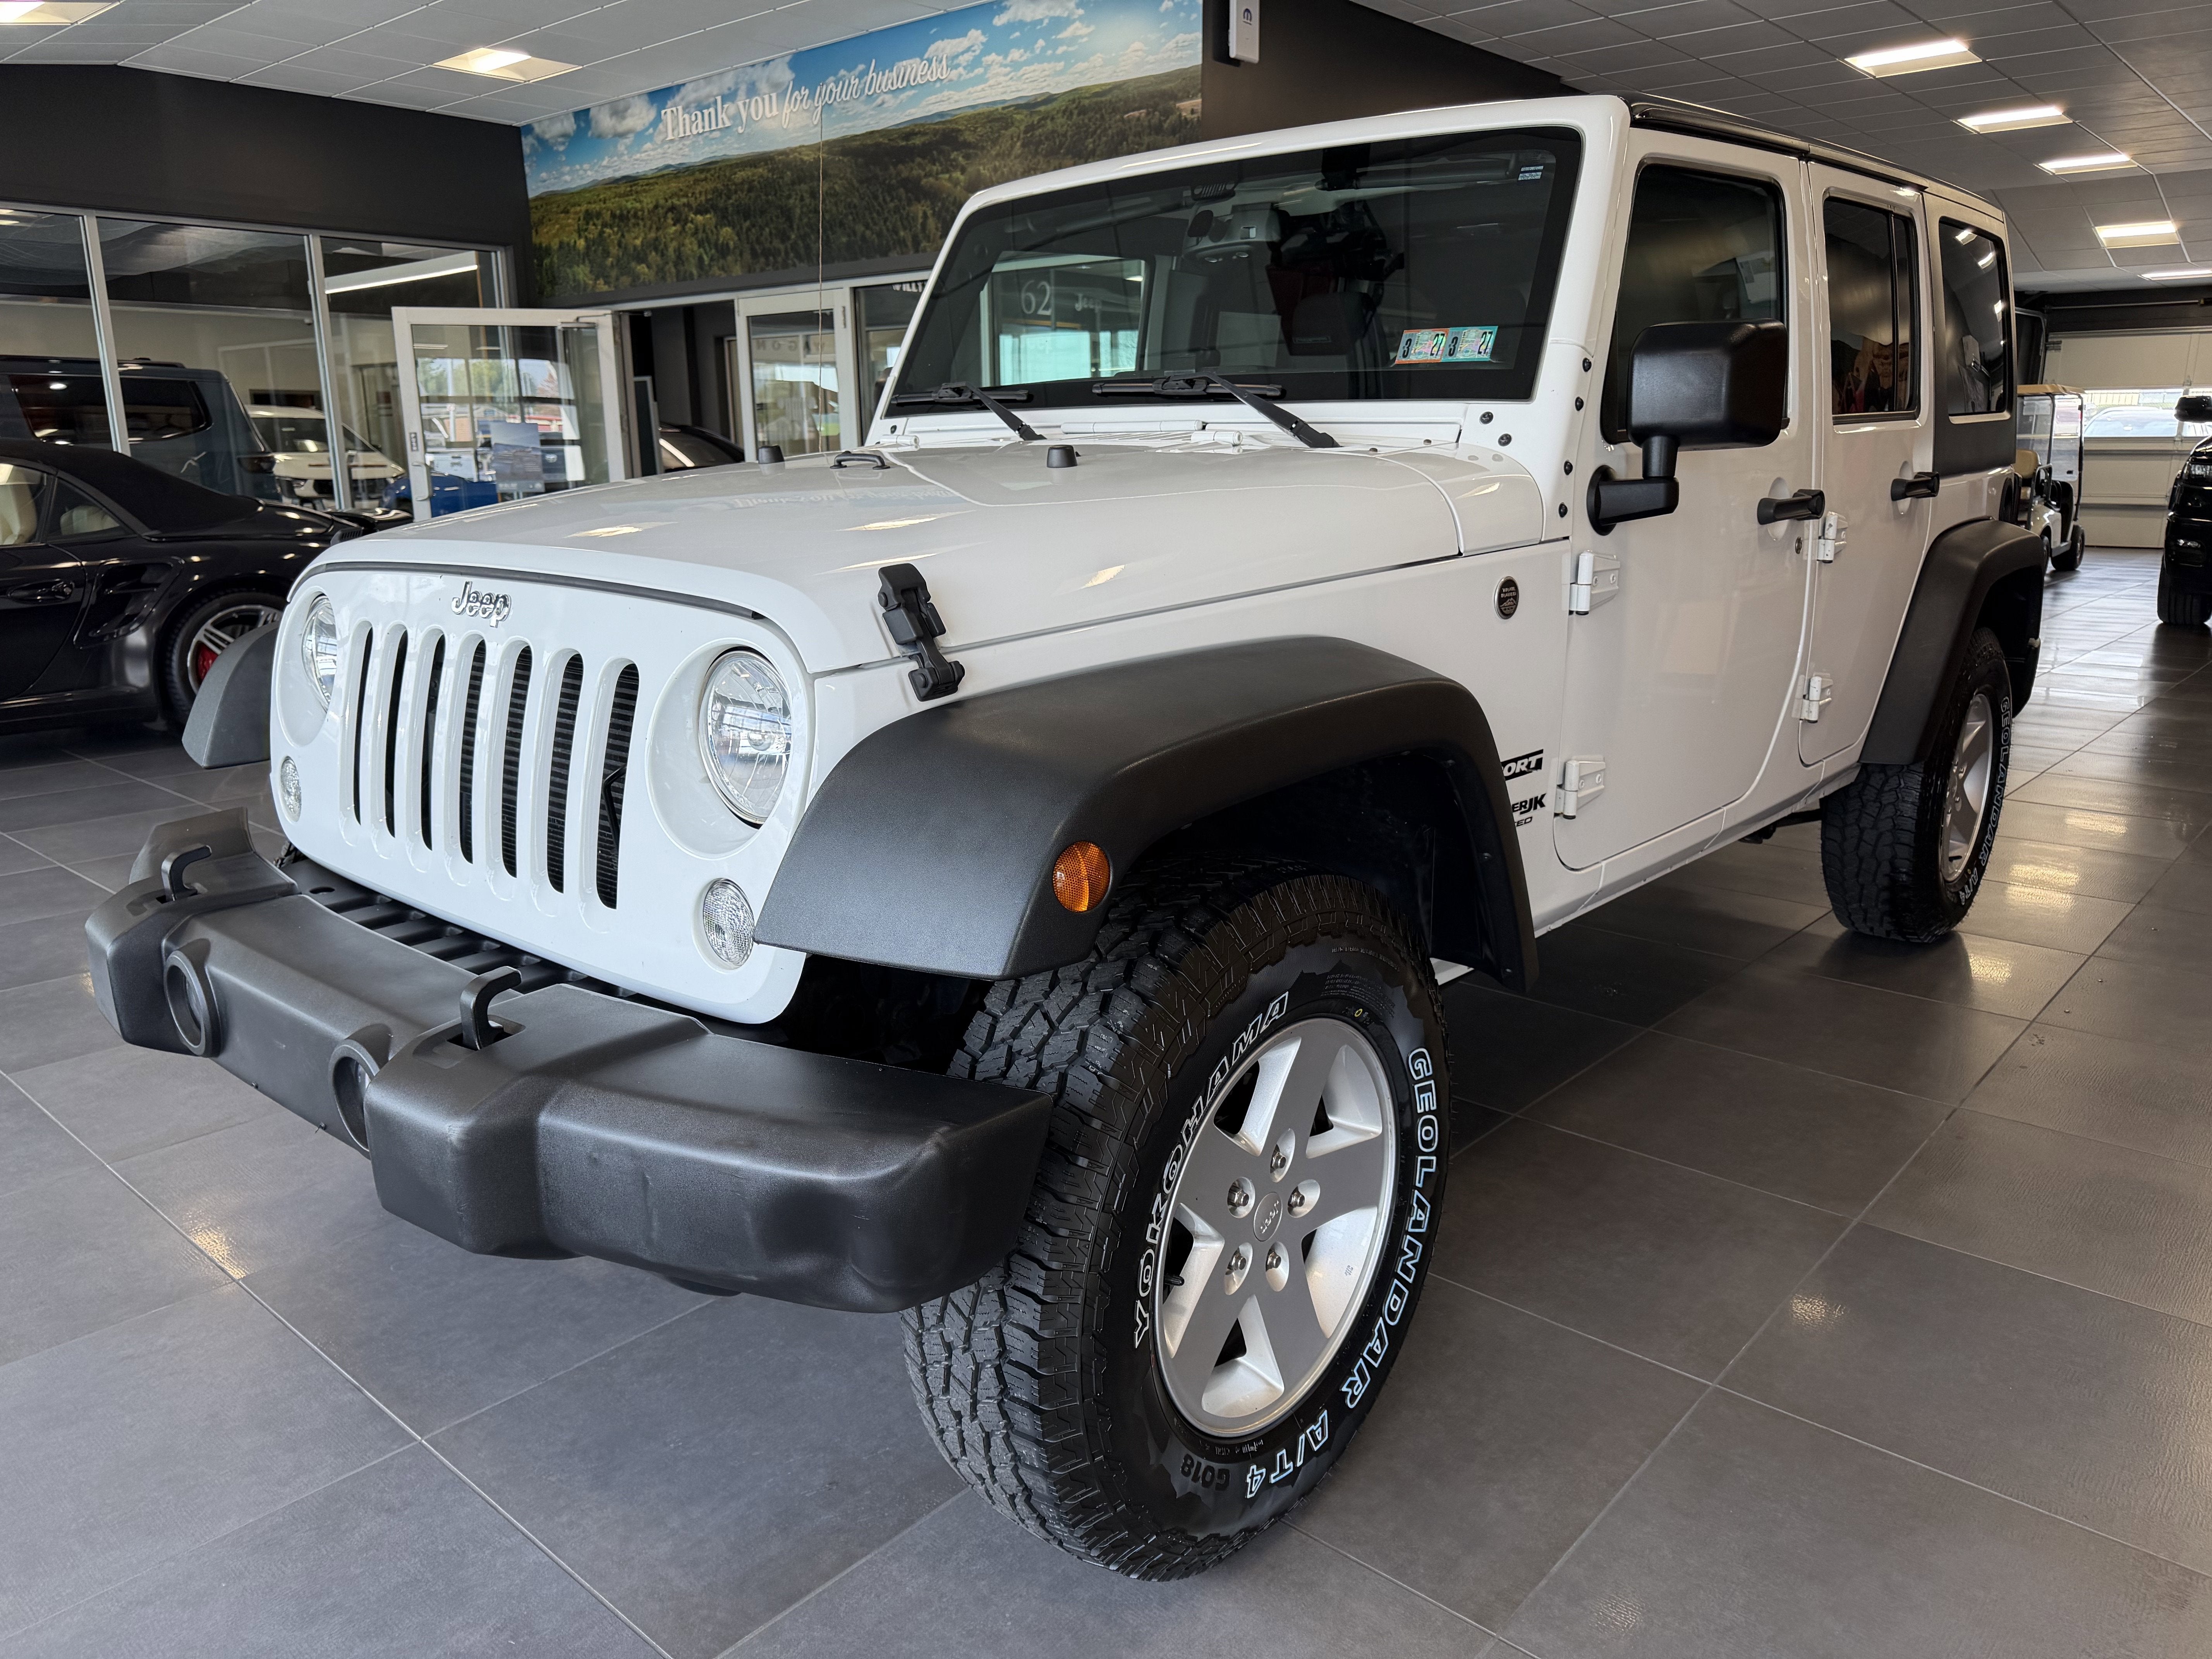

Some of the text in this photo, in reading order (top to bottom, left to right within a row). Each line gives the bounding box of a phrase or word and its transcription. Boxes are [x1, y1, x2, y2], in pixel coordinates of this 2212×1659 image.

[661, 54, 951, 140] Thank you for your business
[892, 282, 927, 293] WILLY
[1402, 333, 1445, 358] 3 27
[1448, 331, 1493, 357] 3 27
[451, 580, 512, 628] Jeep
[1502, 754, 1543, 777] ORT
[1978, 696, 2010, 867] GEOLANDAR
[1133, 990, 1288, 1348] YOKOHAMA
[1340, 1047, 1438, 1409] GEOLANDAR
[1245, 1408, 1328, 1499] A/T4
